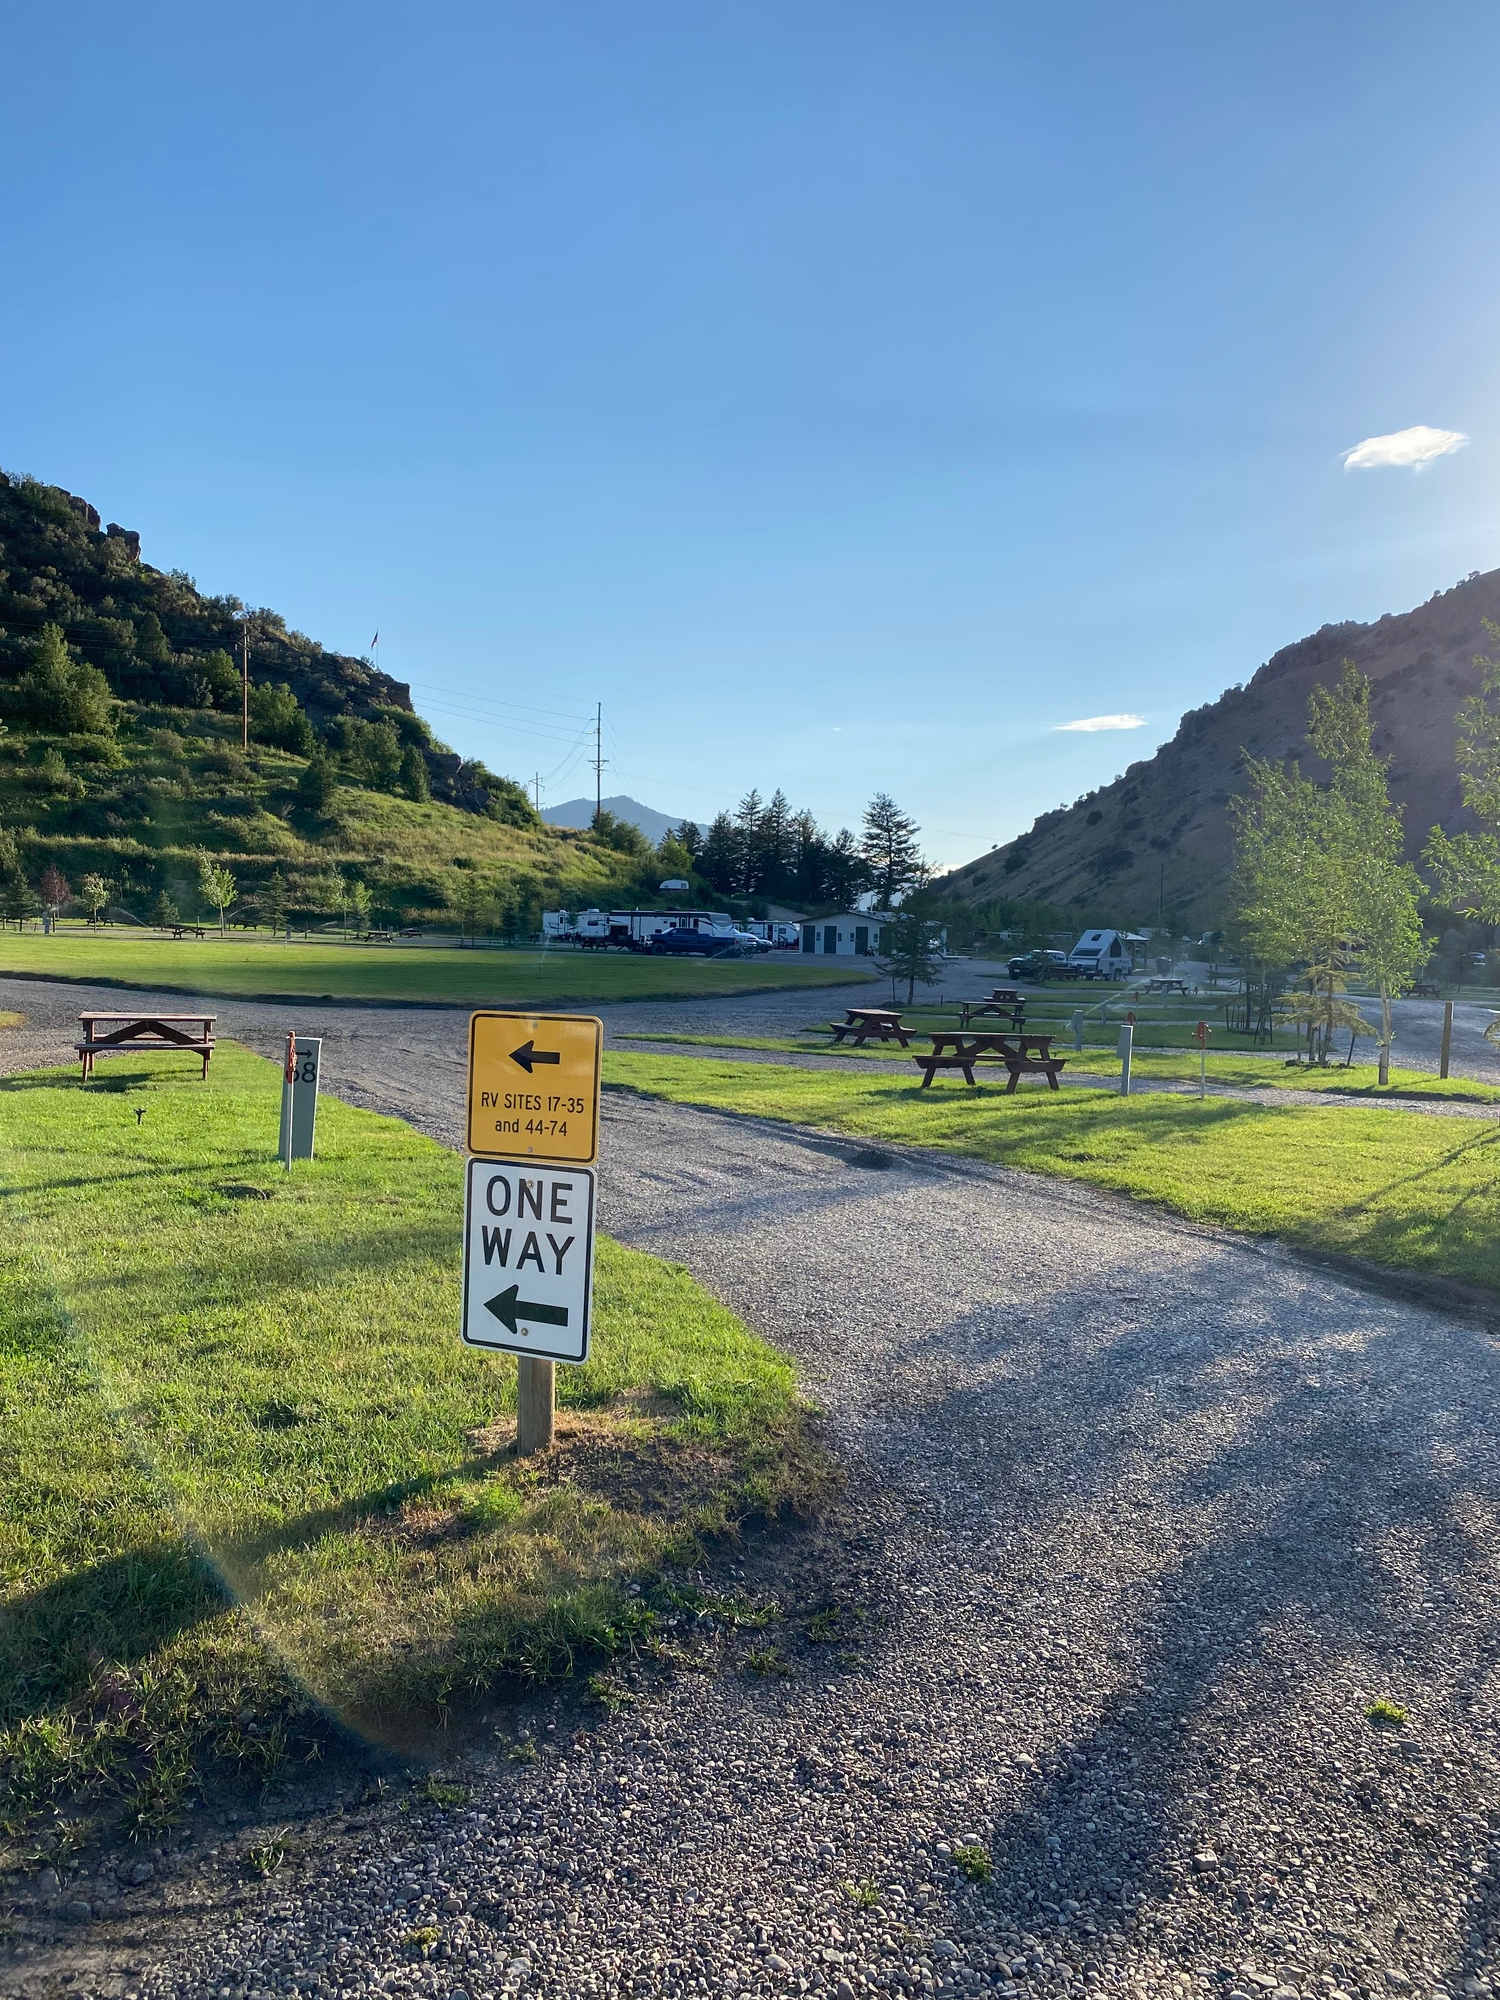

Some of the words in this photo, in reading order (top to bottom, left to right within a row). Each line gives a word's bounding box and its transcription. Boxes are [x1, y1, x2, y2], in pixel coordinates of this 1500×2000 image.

[481, 1092, 499, 1109] RV
[504, 1093, 542, 1111] SITES
[547, 1096, 584, 1114] 17-35
[494, 1118, 520, 1134] and
[525, 1120, 568, 1136] 44-74
[486, 1175, 573, 1225] ONE
[481, 1225, 576, 1276] WAY
